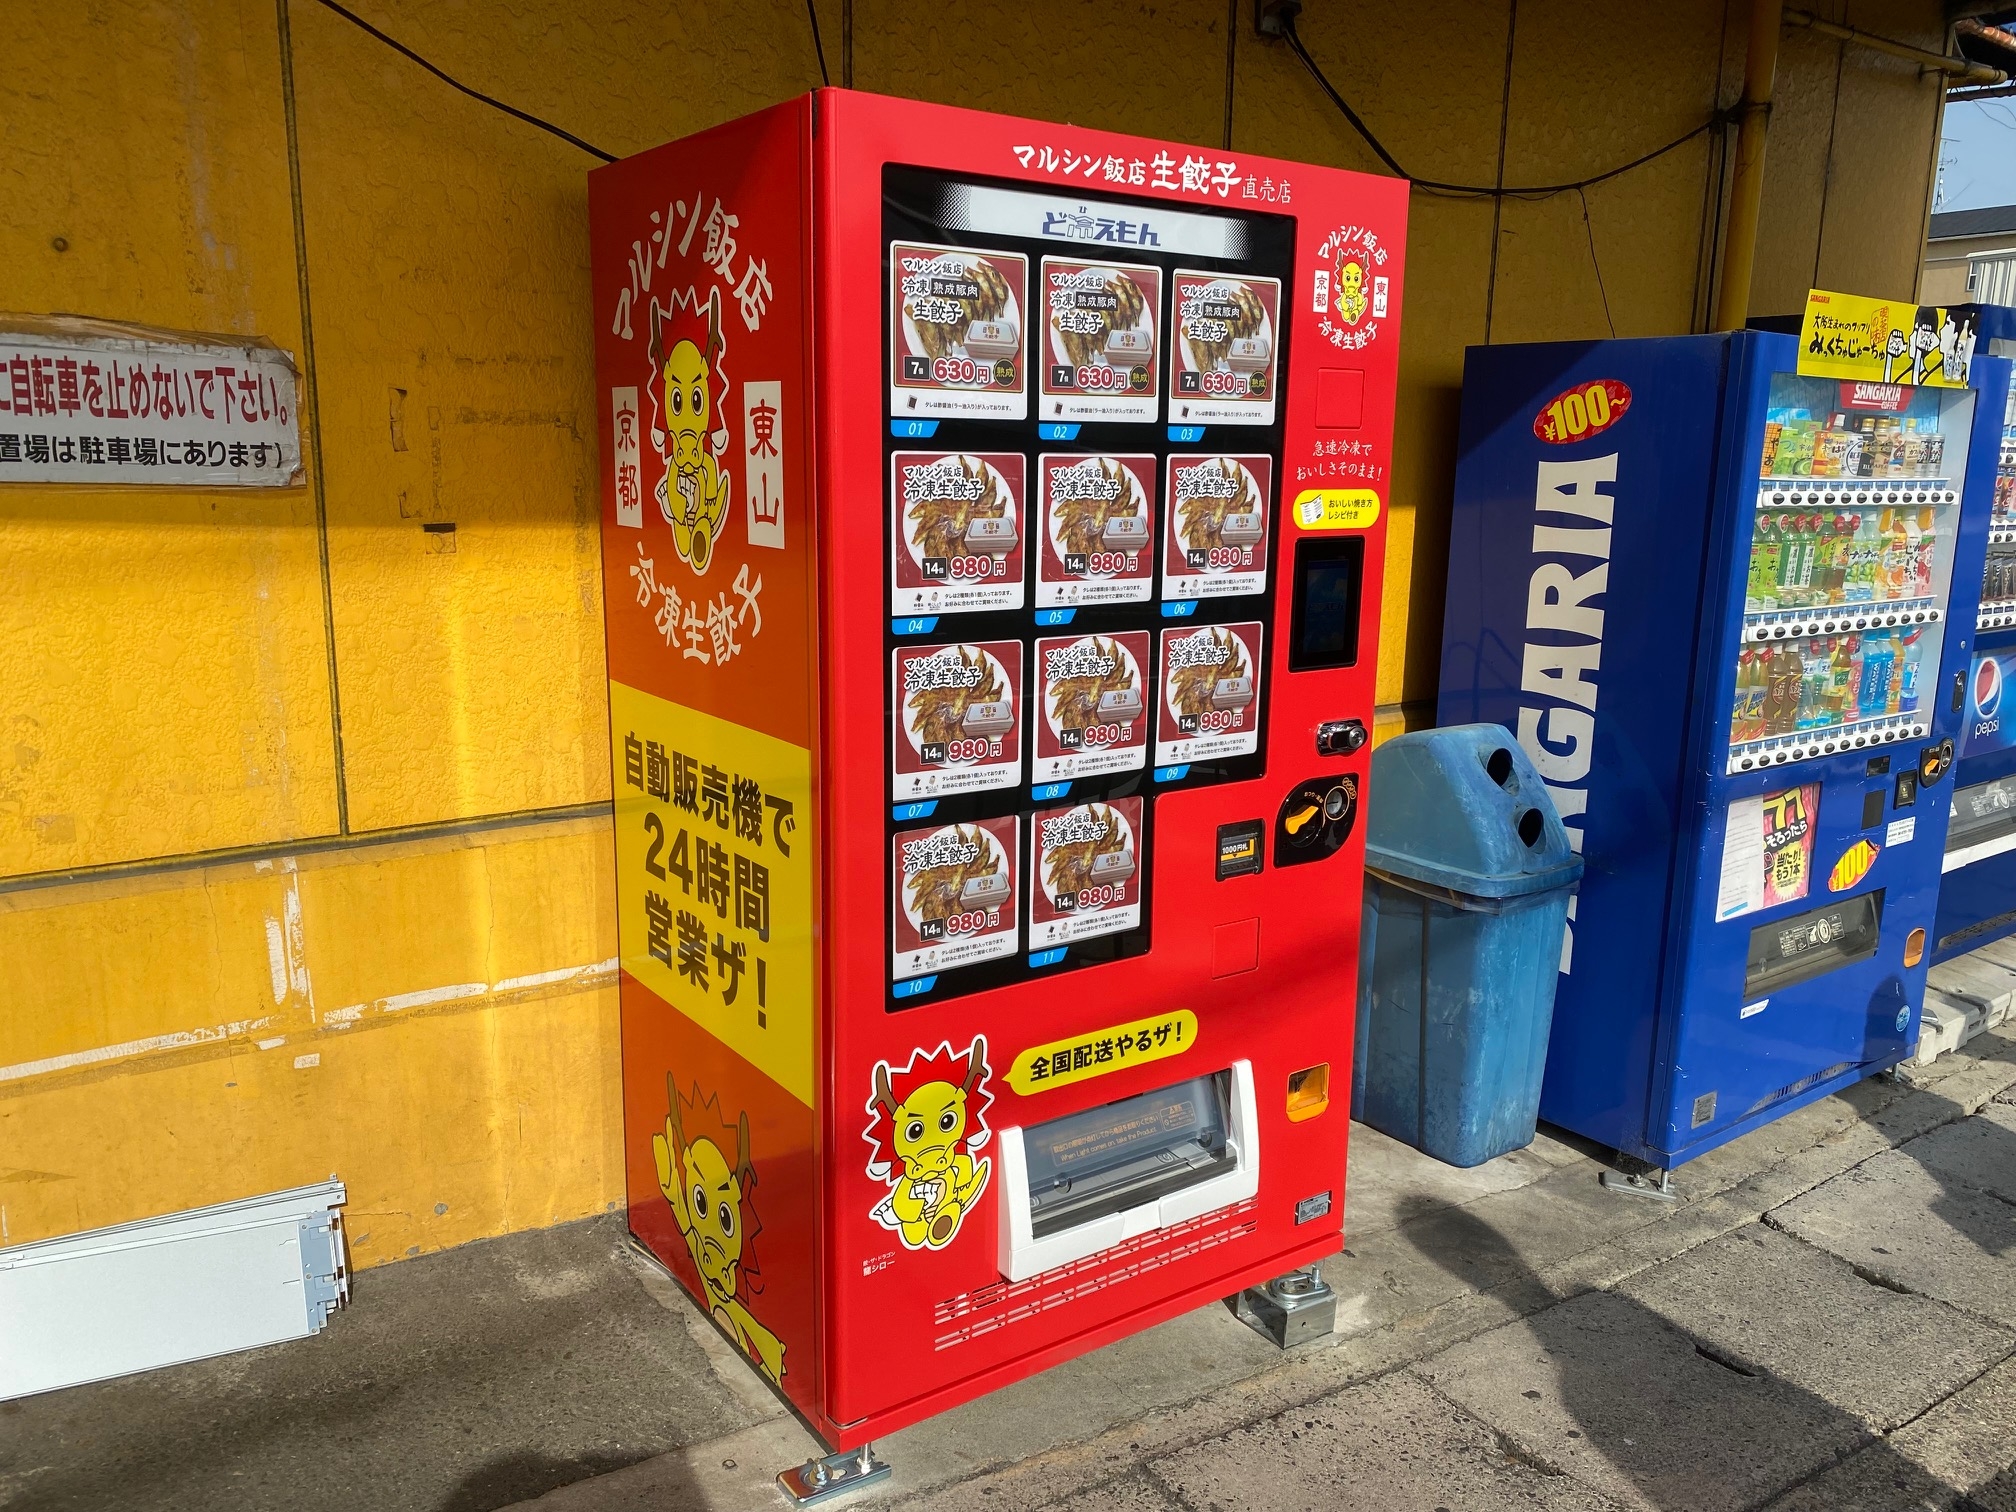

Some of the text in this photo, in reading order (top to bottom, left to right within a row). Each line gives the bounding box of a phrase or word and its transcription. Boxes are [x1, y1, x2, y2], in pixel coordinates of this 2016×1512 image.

[1318, 225, 1388, 265] マルシン飯店
[613, 190, 772, 340] マルシン飯店
[902, 258, 963, 275] マルシン飯店
[902, 278, 930, 295] 冷凍
[1050, 274, 1103, 288] マルシン飯店
[1050, 292, 1074, 308] 冷凍
[1181, 286, 1228, 299] マルシン飯店
[1315, 275, 1327, 307] 京都
[1375, 281, 1386, 312] 東山
[1810, 294, 1830, 304] SANGARIA
[913, 300, 963, 322] 生餃子
[1181, 302, 1201, 317] 冷凍
[1060, 312, 1102, 333] 生餃子
[1188, 320, 1227, 341] 生餃子
[1318, 316, 1377, 350] 冷凍生餃子
[1809, 331, 1885, 361] みっくちゅじゅーちゅ
[933, 359, 990, 382] 630円
[1077, 366, 1126, 388] 630円
[1202, 373, 1246, 393] 630円
[1853, 384, 1901, 402] SANGARIA
[1881, 400, 1898, 410] COFFEE
[908, 422, 923, 436] 01
[1053, 426, 1066, 439] 02
[1181, 428, 1193, 441] 03
[616, 400, 639, 511] 京都
[1313, 439, 1372, 457] 急速冷凍で
[750, 398, 780, 526] 東山
[1296, 462, 1382, 481] おいしさそのまま！
[904, 466, 962, 478] マルシン飯店
[1051, 468, 1101, 479] マルシン飯店
[1177, 468, 1222, 478] マルシン飯店
[905, 480, 983, 499] 冷凍生餃子
[1051, 481, 1120, 500] 冷凍生餃子
[1176, 480, 1238, 498] 冷凍生餃子
[1328, 498, 1373, 508] おいしい焼き方
[1328, 511, 1358, 520] レシピ付き
[1090, 553, 1138, 572] 980円
[1209, 548, 1253, 566] 980円
[951, 557, 1006, 577] 980円
[629, 541, 763, 667] 冷凍生餃子
[1174, 604, 1186, 615] 06
[908, 620, 923, 633] 04
[1050, 611, 1062, 623] 05
[1169, 637, 1212, 648] マルシン飯店
[1047, 647, 1096, 659] マルシン飯店
[1169, 648, 1229, 668] 冷凍生餃子
[905, 657, 961, 669] マルシン飯店
[1046, 659, 1115, 680] 冷凍生餃子
[905, 668, 981, 691] 冷凍生餃子
[1201, 712, 1243, 731] 980円
[1974, 717, 2000, 739] pepsi
[1085, 725, 1132, 745] 980円
[949, 739, 1002, 761] 980円
[1166, 768, 1178, 779] 09
[624, 731, 796, 859] 自動販売機で
[1046, 786, 1058, 798] 08
[908, 804, 923, 817] 07
[1042, 814, 1090, 828] マルシン飯店
[904, 836, 958, 851] マルシン飯店
[1042, 823, 1107, 848] 冷凍生餃子
[1766, 821, 1807, 847] そろったら
[1222, 843, 1248, 854] 1000円札
[1777, 849, 1801, 867] 当たり！
[904, 844, 979, 873] 冷凍生餃子
[643, 812, 770, 943] 24時間
[1776, 863, 1801, 880] もう1本
[1079, 886, 1125, 908] 980円
[947, 912, 1000, 934] 980円
[644, 890, 768, 1031] 営業ザ！
[1043, 952, 1054, 964] 11
[909, 981, 923, 993] 10
[1030, 1021, 1182, 1082] 全国配送やるザ！
[1091, 1143, 1107, 1153] comes
[1116, 1136, 1127, 1145] take
[1129, 1133, 1137, 1141] the
